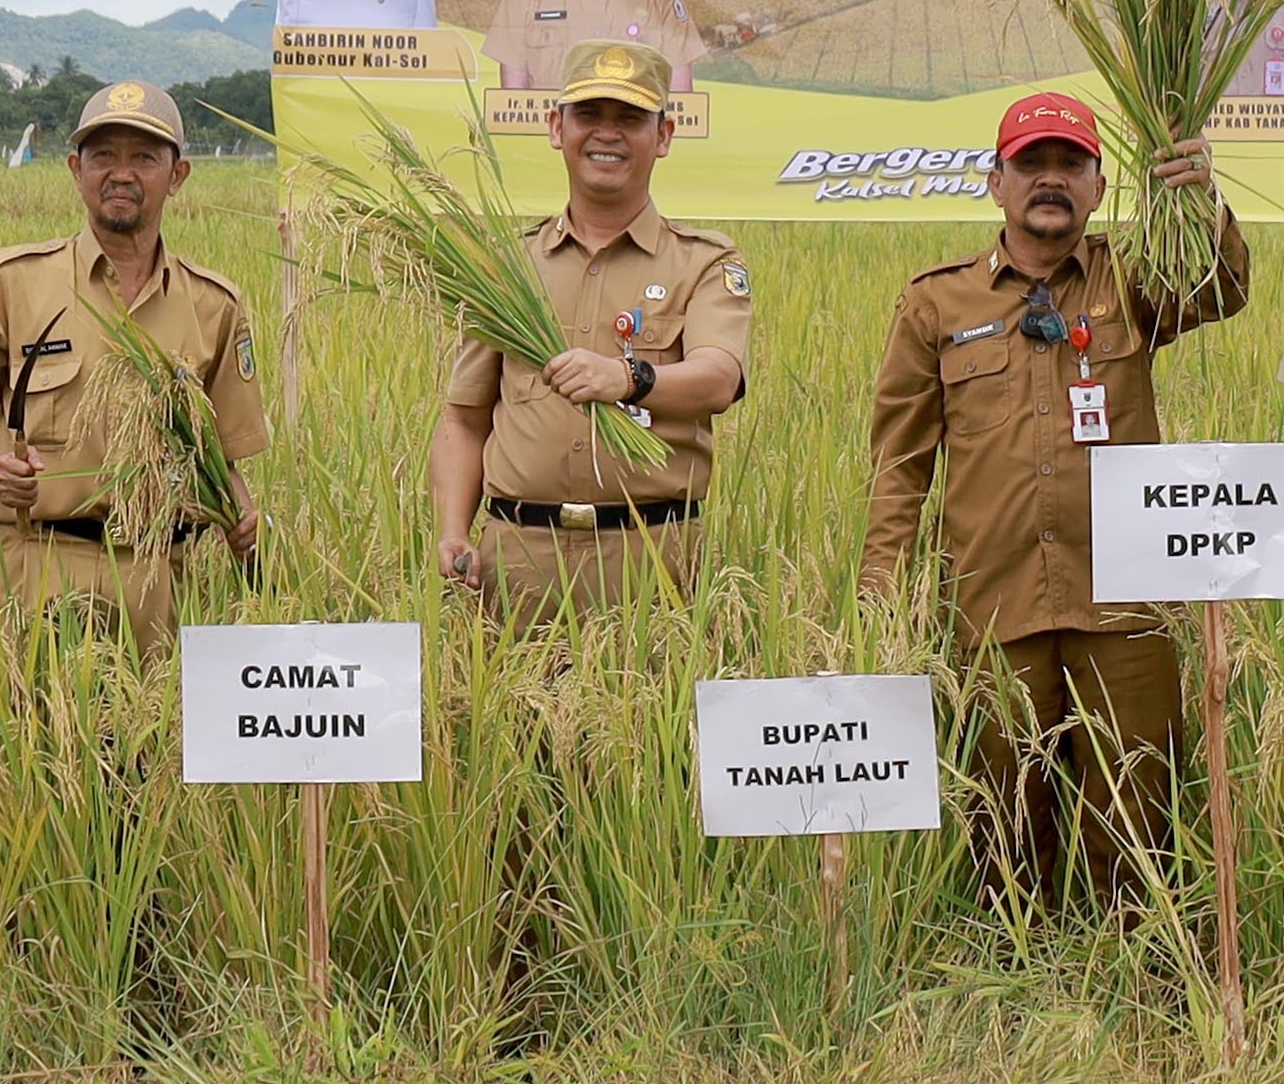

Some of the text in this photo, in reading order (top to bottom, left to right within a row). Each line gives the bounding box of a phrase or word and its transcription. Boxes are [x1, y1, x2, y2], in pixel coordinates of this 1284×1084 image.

[283, 33, 417, 50] SAHBIRIN NOOR
[273, 50, 427, 69] Gubernur Kal-Sel
[493, 111, 540, 124] KEPALA
[1225, 117, 1250, 128] KAB
[815, 175, 988, 200] Kalsel Maj
[1143, 483, 1278, 509] KEPALA
[1167, 531, 1256, 557] DPKP
[241, 665, 362, 689] CAMAT
[238, 715, 365, 738] BAJUIN
[763, 721, 868, 745] BUPATI
[726, 760, 910, 786] TANAH LAUT
